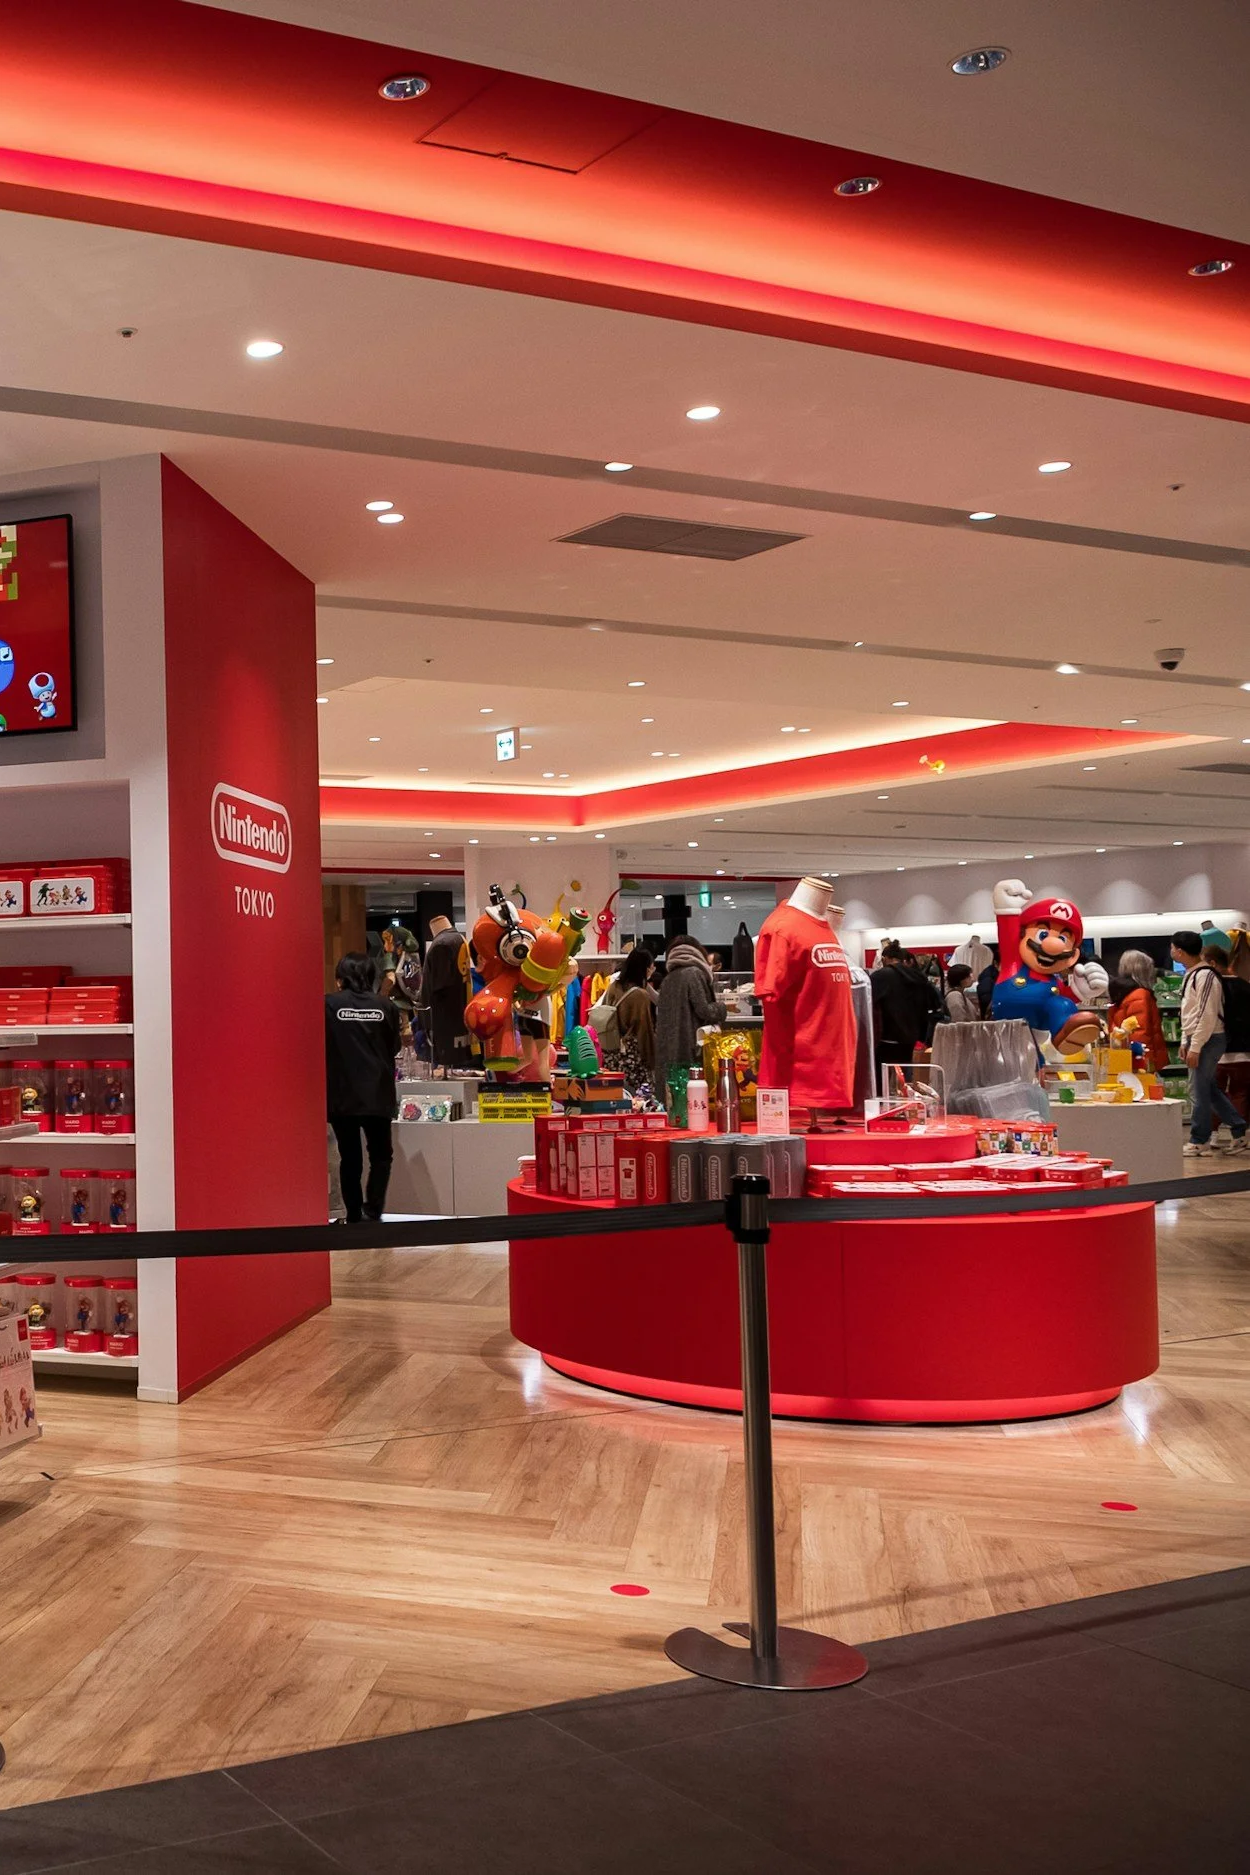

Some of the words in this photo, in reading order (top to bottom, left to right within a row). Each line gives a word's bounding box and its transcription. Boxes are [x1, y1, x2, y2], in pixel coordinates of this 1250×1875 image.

[219, 801, 286, 857] Nintendo
[234, 885, 275, 918] TOKYO
[340, 1010, 381, 1020] Nintendo
